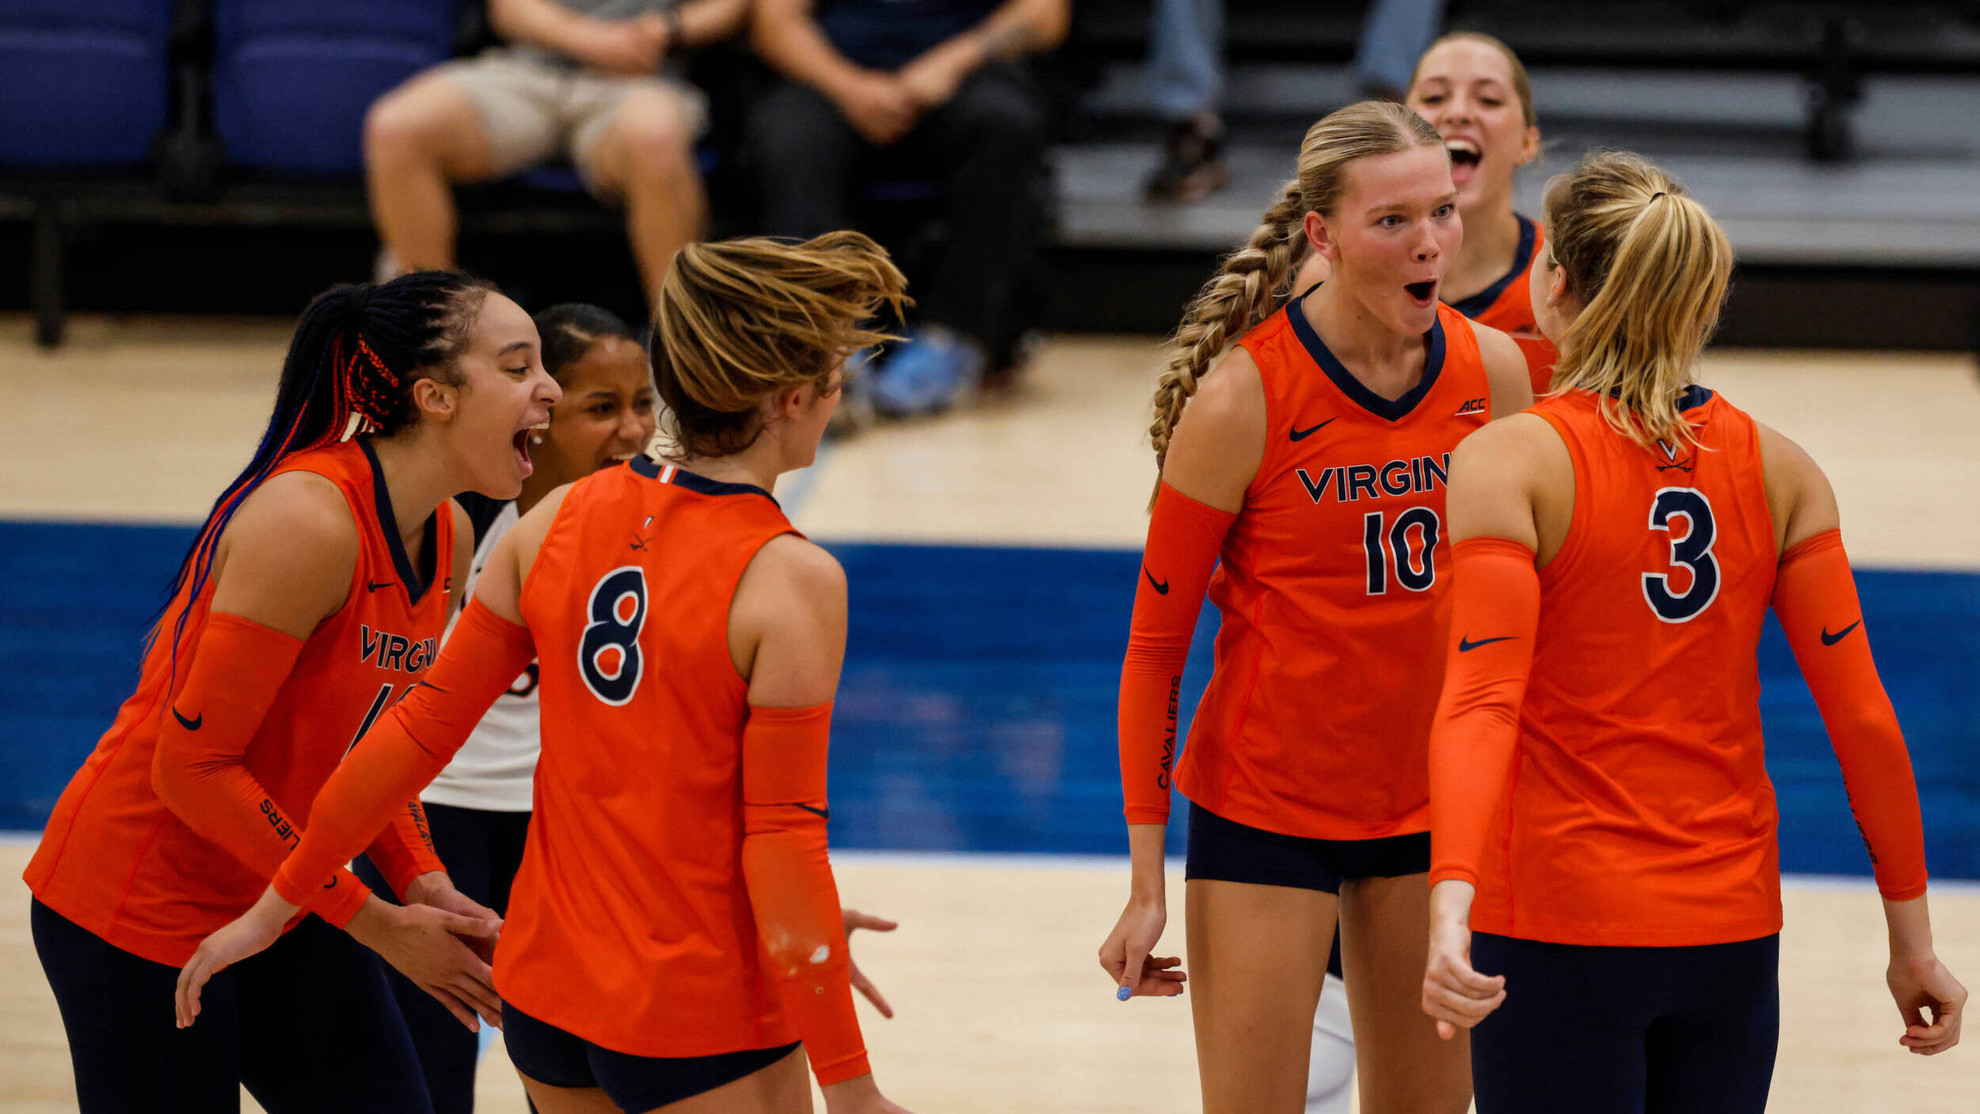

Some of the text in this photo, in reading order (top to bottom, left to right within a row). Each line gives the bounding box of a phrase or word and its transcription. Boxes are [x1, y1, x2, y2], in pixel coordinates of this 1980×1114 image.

[1458, 398, 1486, 413] ACC
[1364, 506, 1440, 595] 10
[1641, 486, 1721, 624] 3
[577, 565, 649, 707] 8
[341, 682, 417, 763] 1
[1157, 674, 1181, 790] CAVALIERS
